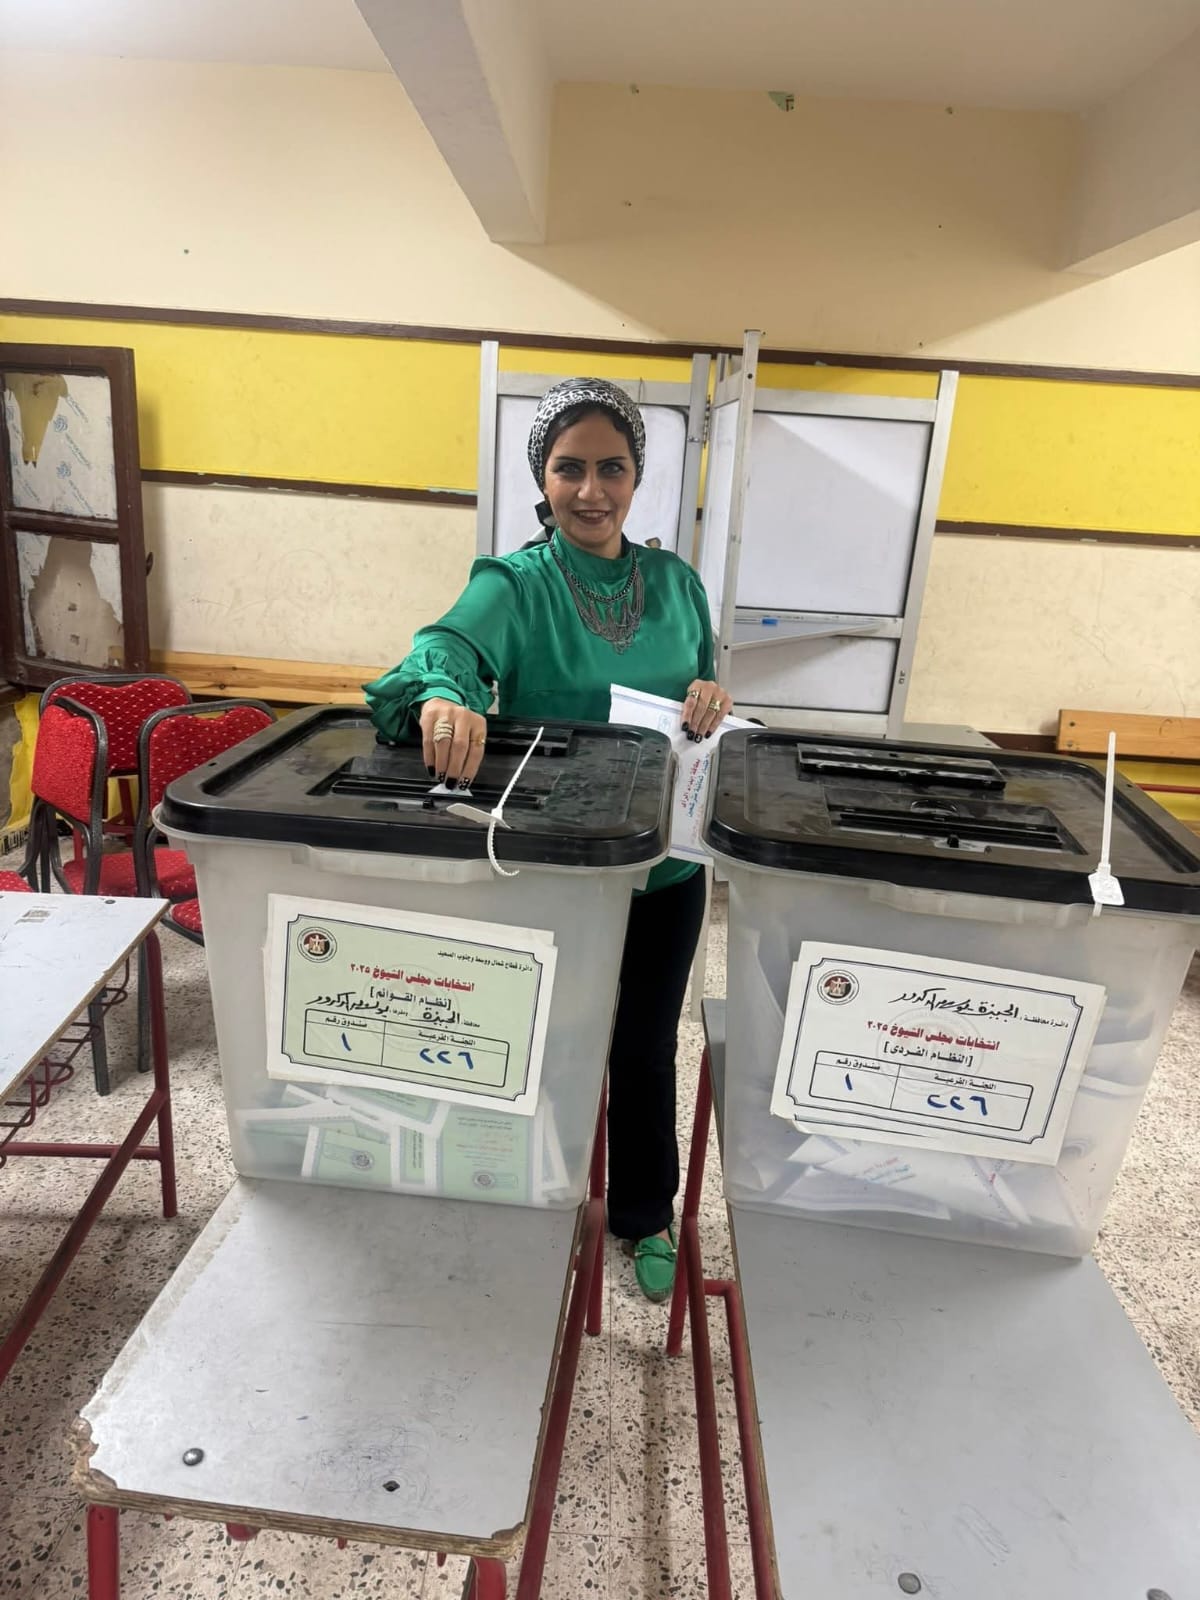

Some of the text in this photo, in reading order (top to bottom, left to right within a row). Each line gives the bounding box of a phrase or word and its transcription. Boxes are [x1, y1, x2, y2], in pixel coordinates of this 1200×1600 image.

[350, 963, 475, 992] انتخابات مجلس الشيوخ ٢٠٢٥
[325, 1016, 368, 1028] صندوق رقم
[418, 1030, 476, 1046] اللجنة الفرعية
[867, 1020, 1000, 1051] انتخابات مجلس الشيوخ ٢٠٢٥
[835, 1058, 881, 1071] صندوق رقم
[933, 1073, 997, 1090] اللجنة الفرعية
